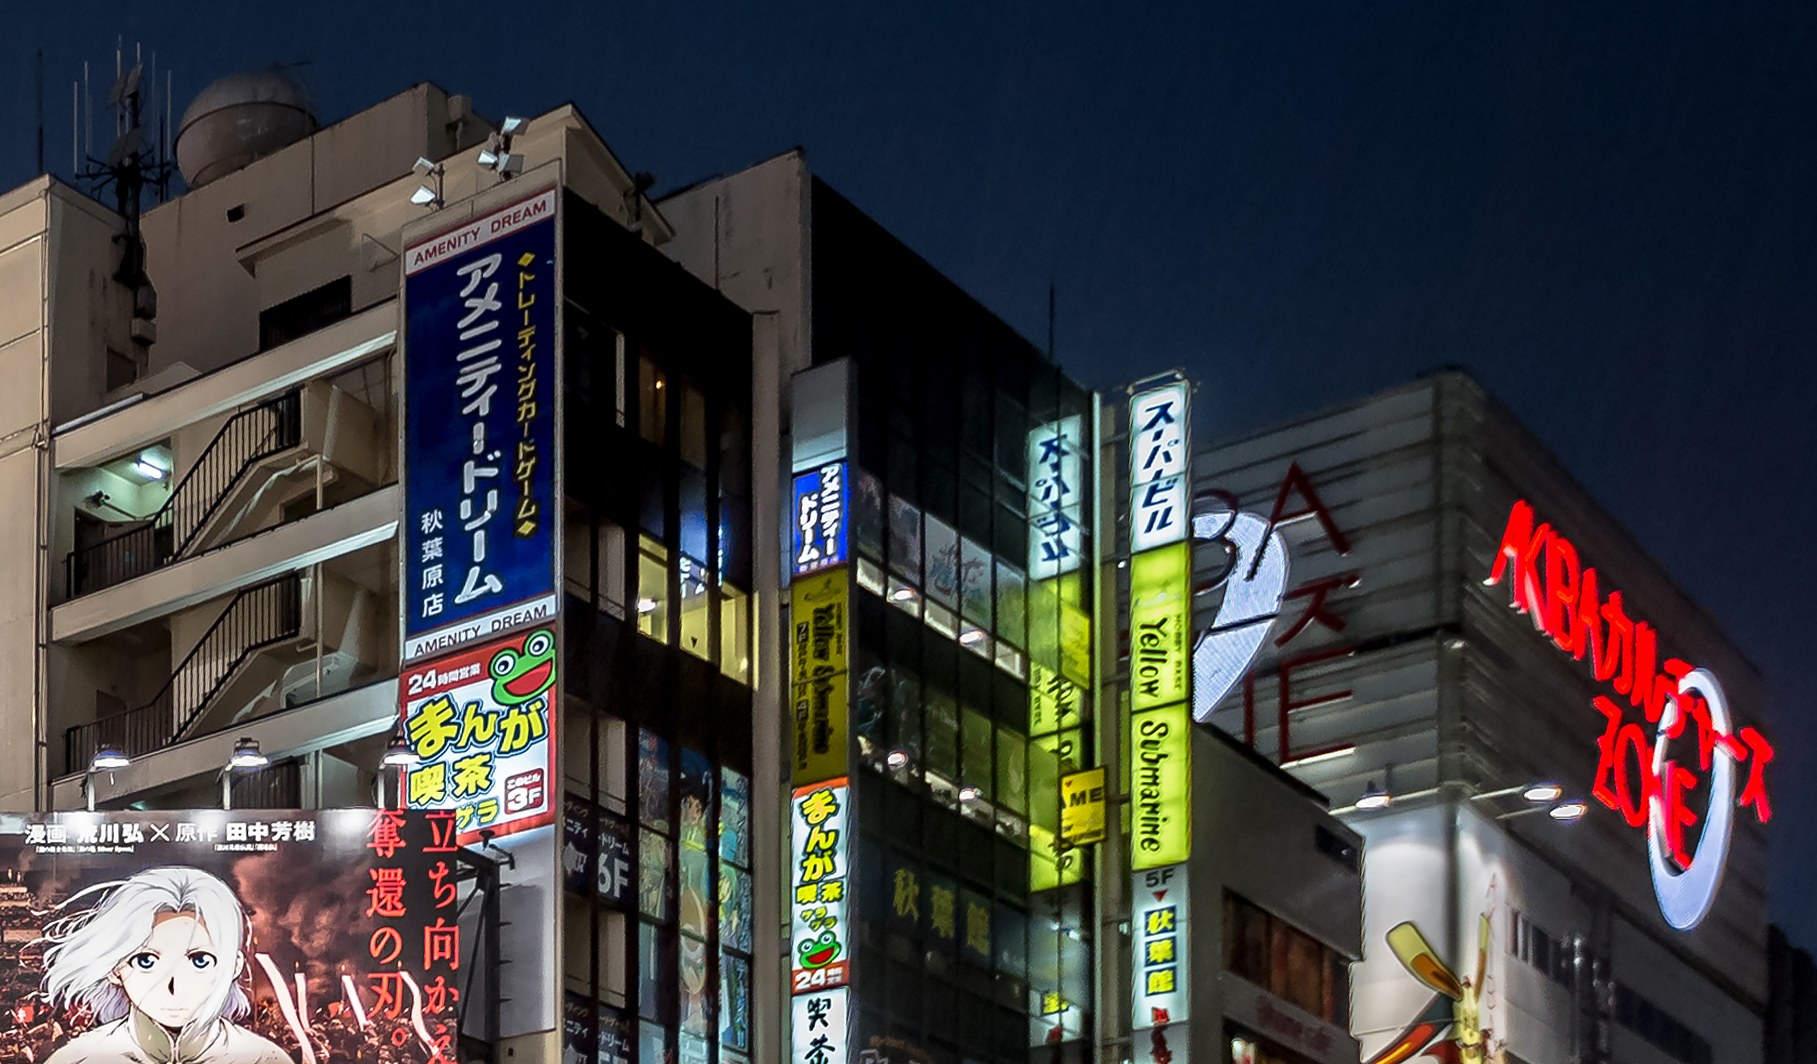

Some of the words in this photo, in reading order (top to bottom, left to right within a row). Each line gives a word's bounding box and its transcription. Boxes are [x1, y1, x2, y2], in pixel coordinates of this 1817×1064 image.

[414, 227, 480, 266] AMENITY
[491, 200, 547, 234] DREAM
[1142, 400, 1177, 534] スーパービル
[421, 509, 445, 618] 秋葉原店
[414, 624, 481, 656] AMENITY
[491, 603, 548, 631] DREAM
[1138, 616, 1173, 699] Yellow
[407, 698, 549, 760] まんが
[409, 752, 495, 809] 喫茶
[507, 788, 544, 813] 3F
[1139, 719, 1164, 855] Submarine
[226, 821, 315, 843] 田中芳樹
[1145, 870, 1175, 889] 5F
